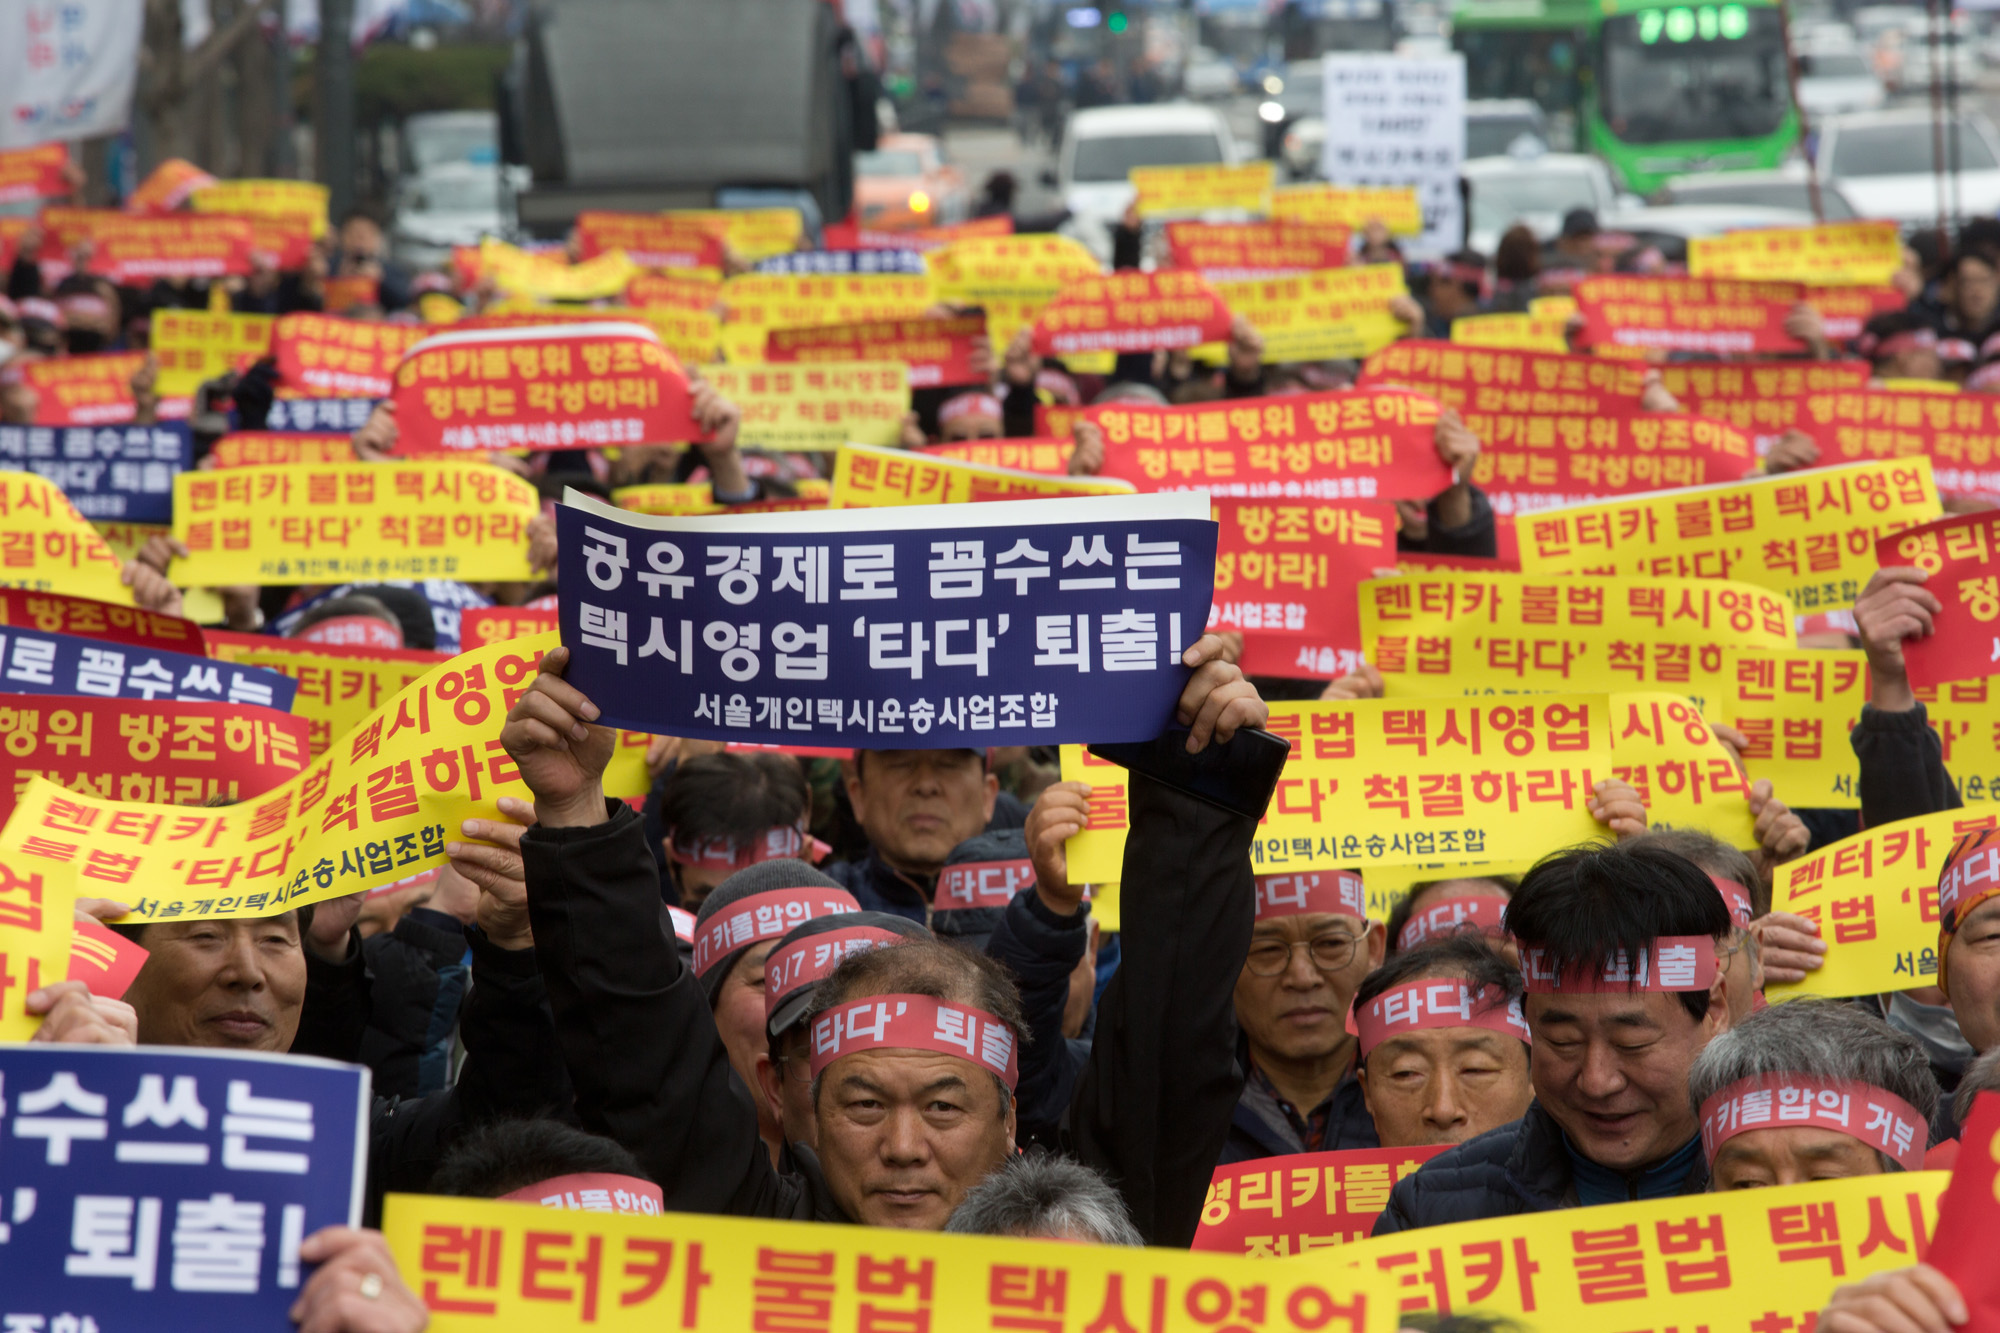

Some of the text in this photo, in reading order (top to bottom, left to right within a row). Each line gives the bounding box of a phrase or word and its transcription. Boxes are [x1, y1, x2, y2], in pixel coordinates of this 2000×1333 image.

[188, 472, 294, 513] 렌터카
[306, 469, 376, 506] 불법
[1532, 508, 1659, 560] 렌터카
[1675, 492, 1756, 542] 불법
[1774, 468, 1928, 527] 택시영업
[185, 516, 252, 553] 불법
[1236, 505, 1382, 549] 방조하는
[582, 525, 1183, 606] 공유경제로 꼼수쓰는
[579, 601, 1182, 682] 택시영업 ‘타다’ 퇴출!
[1374, 578, 1787, 640] 렌터카 불법 택시영업
[118, 711, 302, 772] 방조하는
[693, 692, 1060, 737] 서울개인택시운송사업조합
[1381, 702, 1591, 767] 택시영업
[42, 795, 228, 850] 렌터카
[243, 758, 333, 843] 불법
[18, 834, 142, 884] 불법
[128, 822, 448, 920] 서울개인택시운송사업조합
[1786, 826, 1933, 902] 렌터카
[933, 1006, 1018, 1076] 퇴출
[1717, 1084, 1849, 1142] 카풀합의
[1863, 1101, 1916, 1155] 거부
[64, 1191, 306, 1295] 퇴출!
[420, 1222, 712, 1330] 렌터카
[752, 1244, 936, 1333] 불법
[1570, 1212, 1734, 1308] 불법
[1766, 1192, 1950, 1278] 택시
